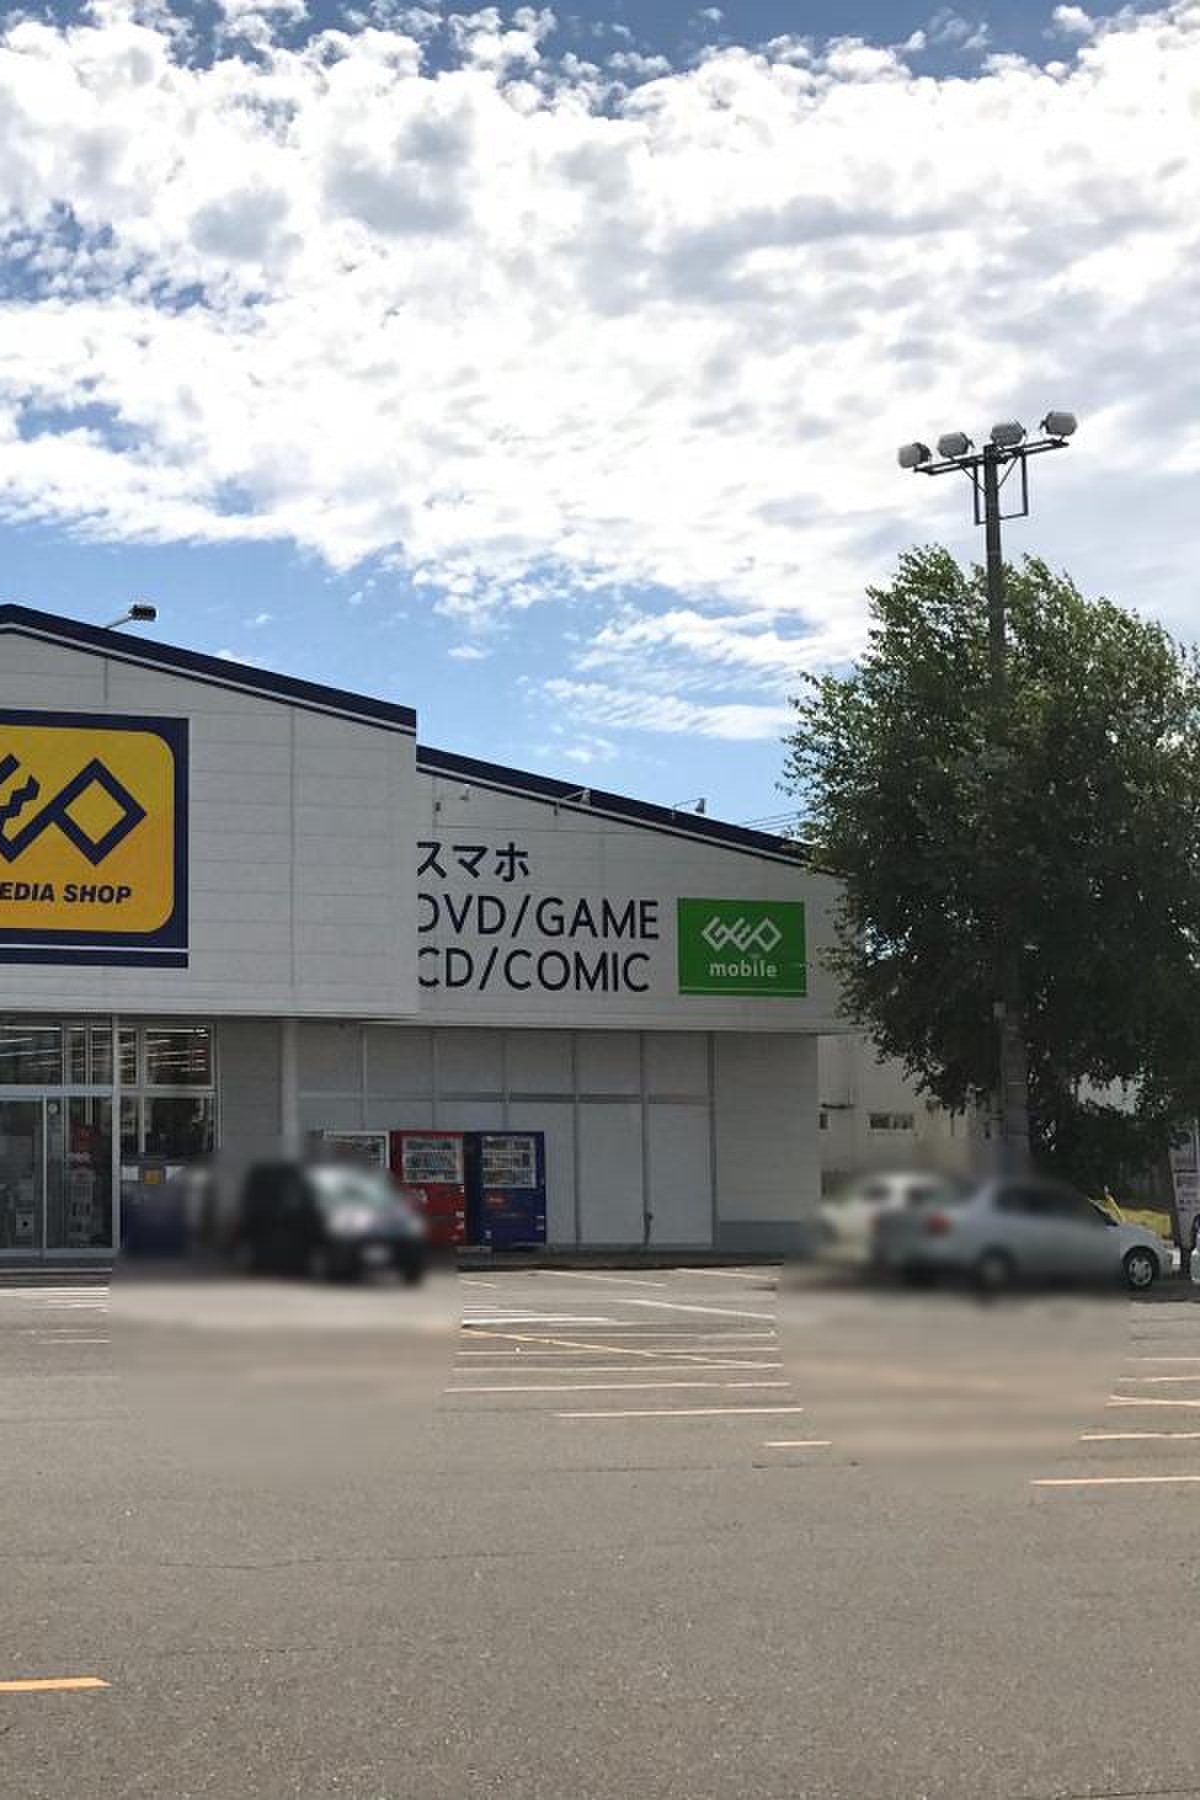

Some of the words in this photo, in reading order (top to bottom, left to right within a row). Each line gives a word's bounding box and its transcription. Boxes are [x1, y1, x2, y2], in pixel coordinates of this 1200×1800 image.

[417, 841, 530, 882] スマホ
[63, 884, 132, 904] SHOP
[710, 960, 778, 978] mobile
